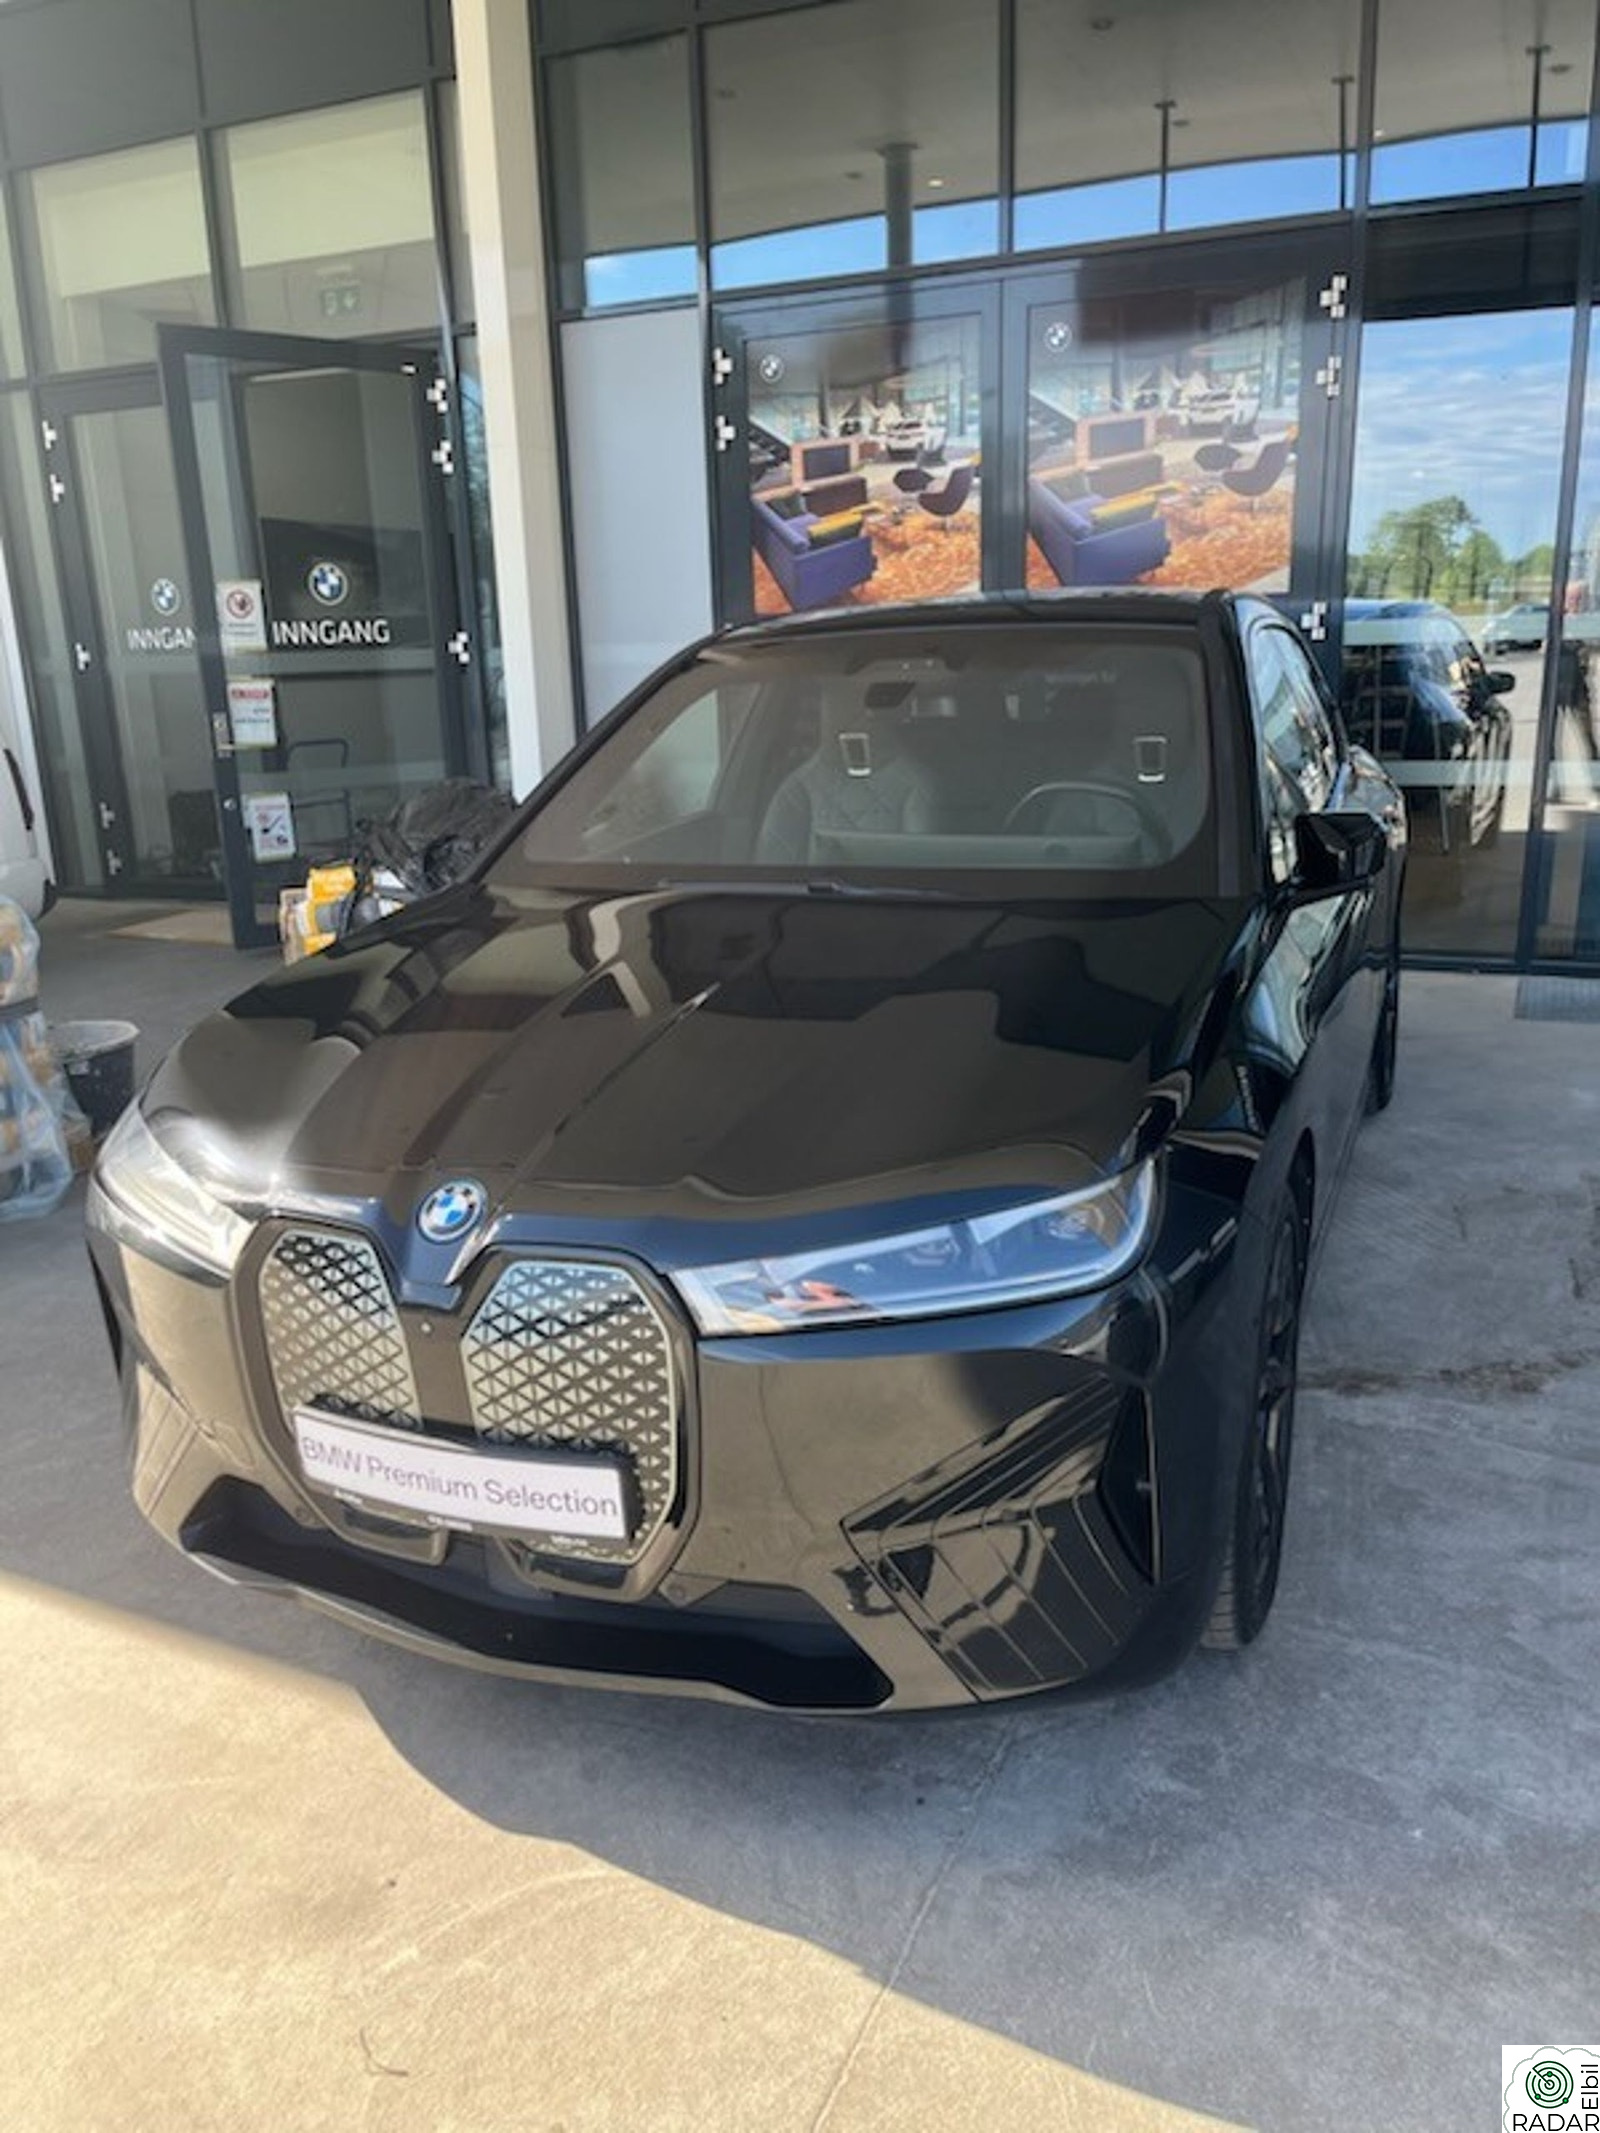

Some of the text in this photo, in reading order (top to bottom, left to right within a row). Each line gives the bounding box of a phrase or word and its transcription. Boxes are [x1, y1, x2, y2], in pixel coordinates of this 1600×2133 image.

[127, 626, 196, 650] INNGAN
[272, 619, 390, 645] INNGANG
[302, 1437, 618, 1516] BMW Premium Selection
